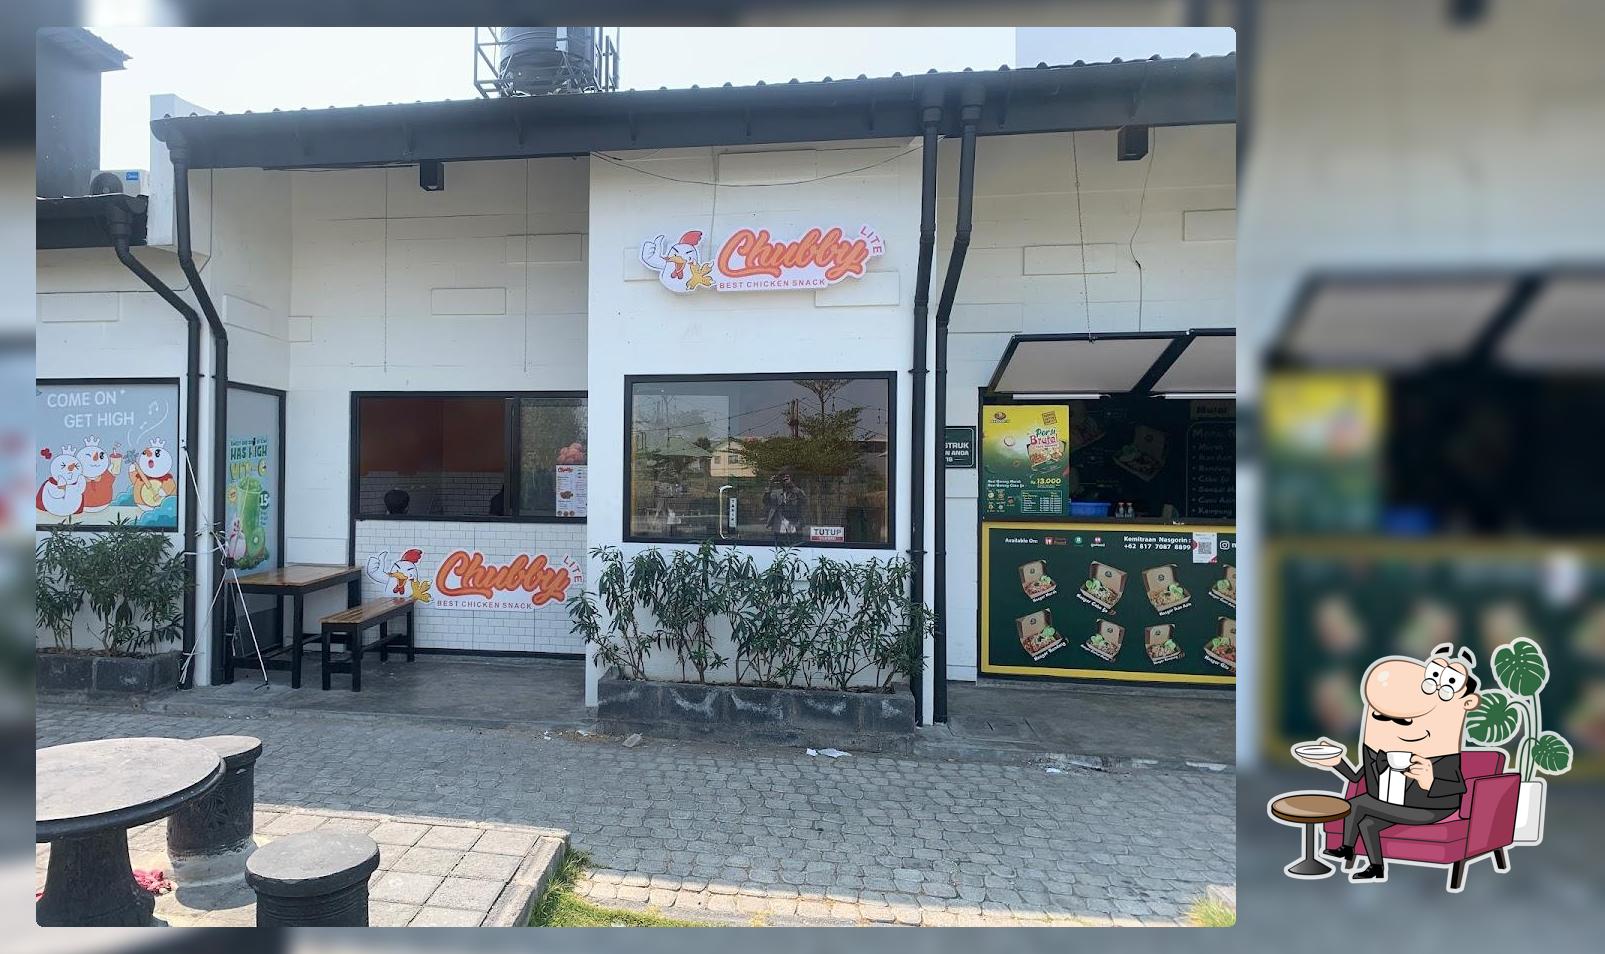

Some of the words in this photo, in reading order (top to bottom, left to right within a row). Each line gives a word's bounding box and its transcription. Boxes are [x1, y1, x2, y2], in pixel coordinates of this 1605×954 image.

[717, 227, 870, 281] Chubby
[859, 225, 883, 256] LITE
[719, 281, 743, 289] BEST
[746, 280, 789, 288] CHICKEN
[47, 392, 91, 408] COME
[94, 391, 117, 405] ON
[64, 413, 93, 428] GET
[97, 411, 134, 427] HIGH
[230, 446, 246, 461] HAS
[813, 528, 842, 536] TUTUP
[435, 550, 571, 606] Chubby
[562, 555, 584, 583] LITE
[461, 600, 500, 608] CHICKEN
